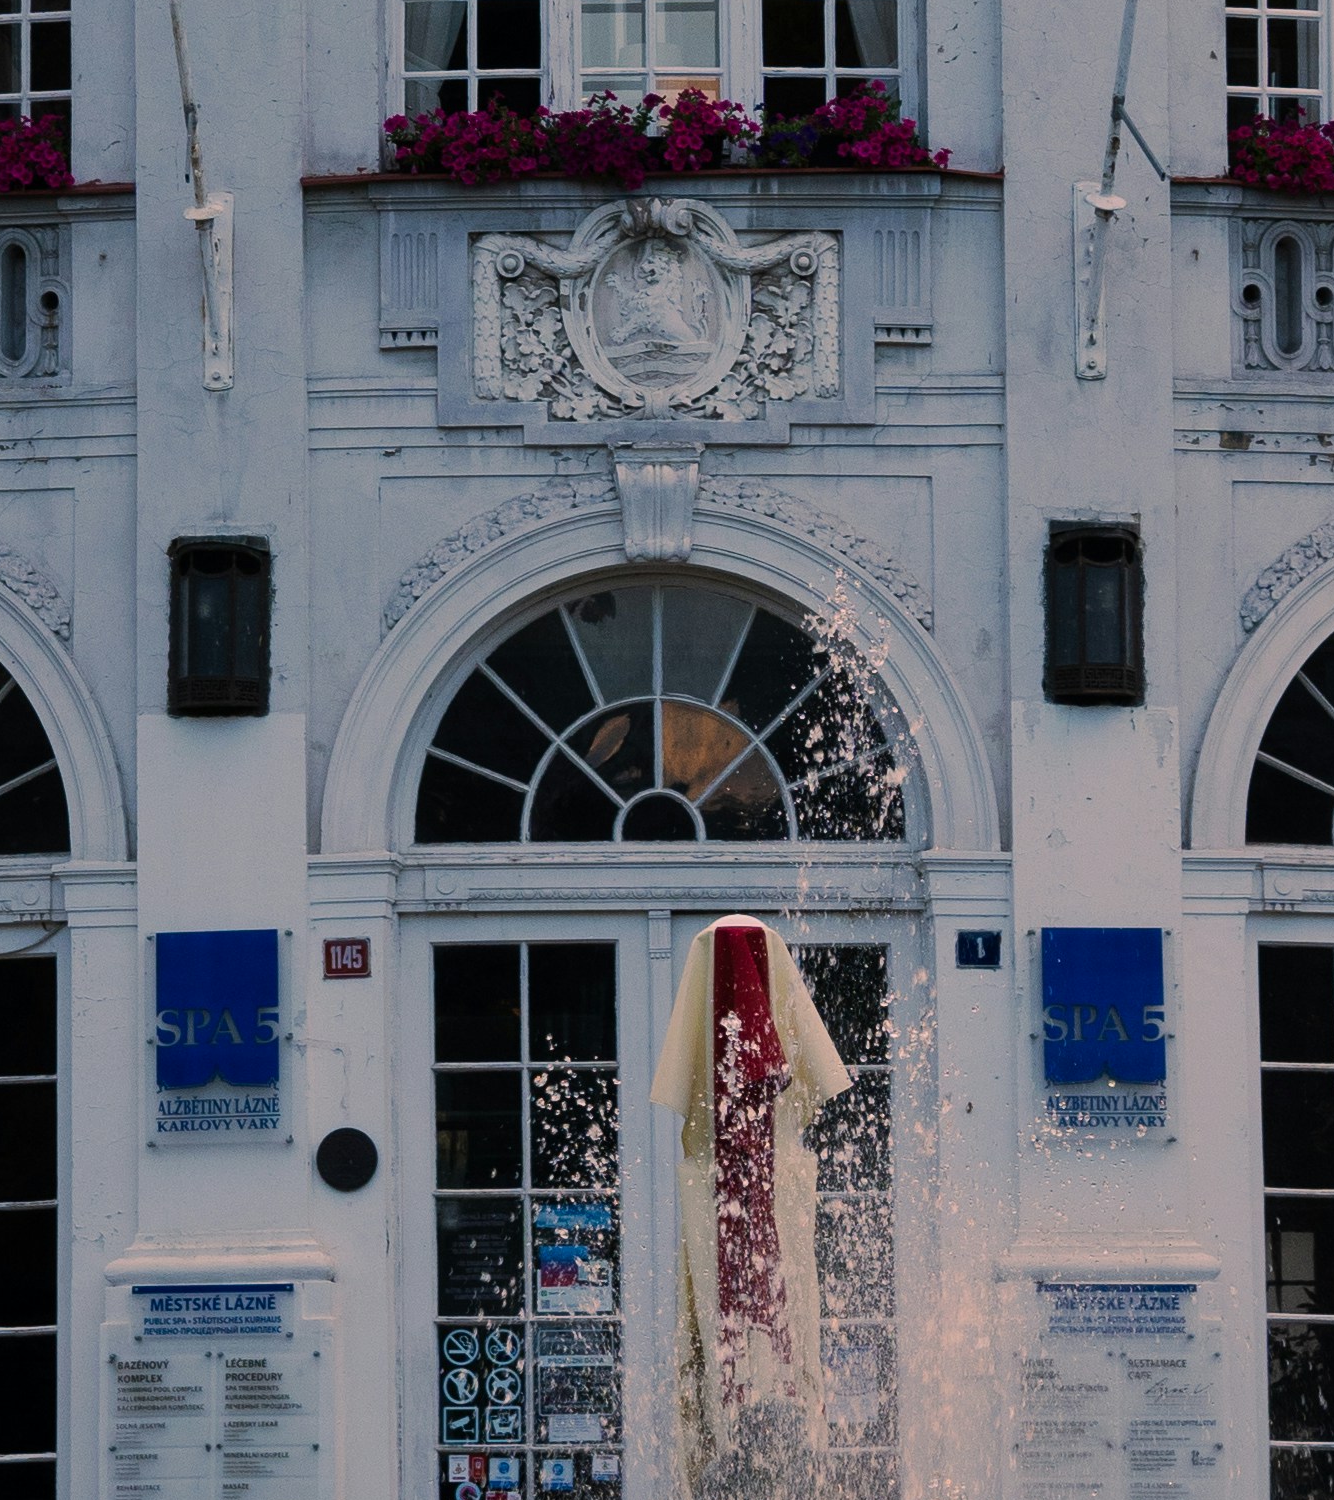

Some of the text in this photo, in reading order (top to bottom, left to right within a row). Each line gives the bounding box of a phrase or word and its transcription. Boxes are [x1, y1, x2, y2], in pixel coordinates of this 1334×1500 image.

[330, 945, 363, 970] 1145
[156, 1006, 280, 1048] SPA 5
[1043, 1004, 1166, 1042] SPA 5
[158, 1094, 280, 1116] ALŽBĚTINY LÁZNĚ
[157, 1117, 280, 1133] KARLOVY VARY
[1057, 1115, 1167, 1128] ARLOVY VARY
[150, 1293, 277, 1312] MĚSTSKÉ LÁZNĚ
[143, 1317, 171, 1326] PUBLIC
[172, 1316, 187, 1325] SPA
[117, 1359, 169, 1370] BAZÉNOVÝ
[225, 1358, 267, 1368] LÉČEBNÉ
[117, 1374, 163, 1383] KOMPLEX
[225, 1373, 283, 1381] PROCEDURY
